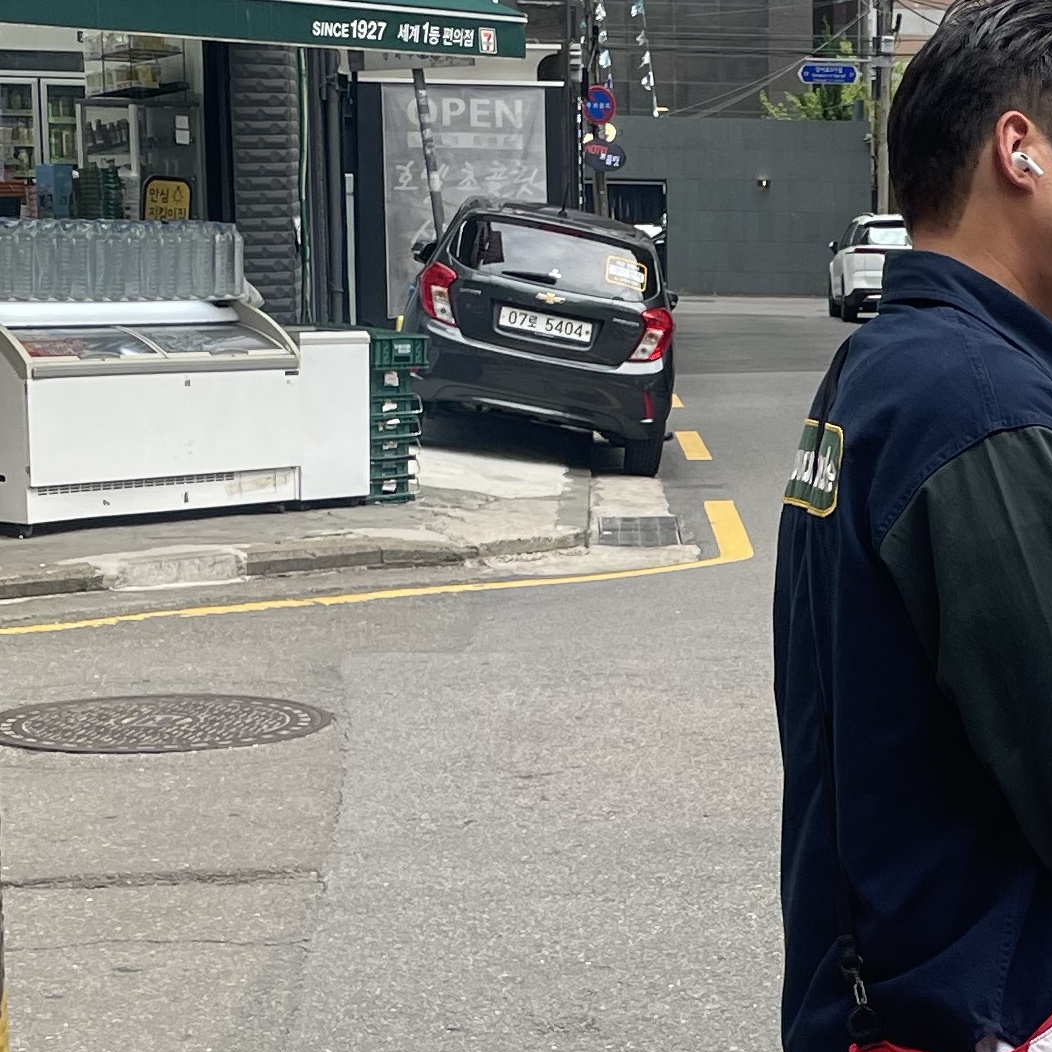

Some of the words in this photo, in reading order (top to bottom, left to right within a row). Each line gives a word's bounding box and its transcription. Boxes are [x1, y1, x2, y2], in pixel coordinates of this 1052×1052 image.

[312, 21, 350, 38] SINCE
[350, 19, 387, 41] 1927
[397, 23, 420, 43] 세계
[422, 22, 441, 45] 1등
[442, 27, 475, 48] 편의점
[406, 97, 523, 129] OPEN
[149, 187, 170, 204] 안심
[545, 317, 583, 338] 5404
